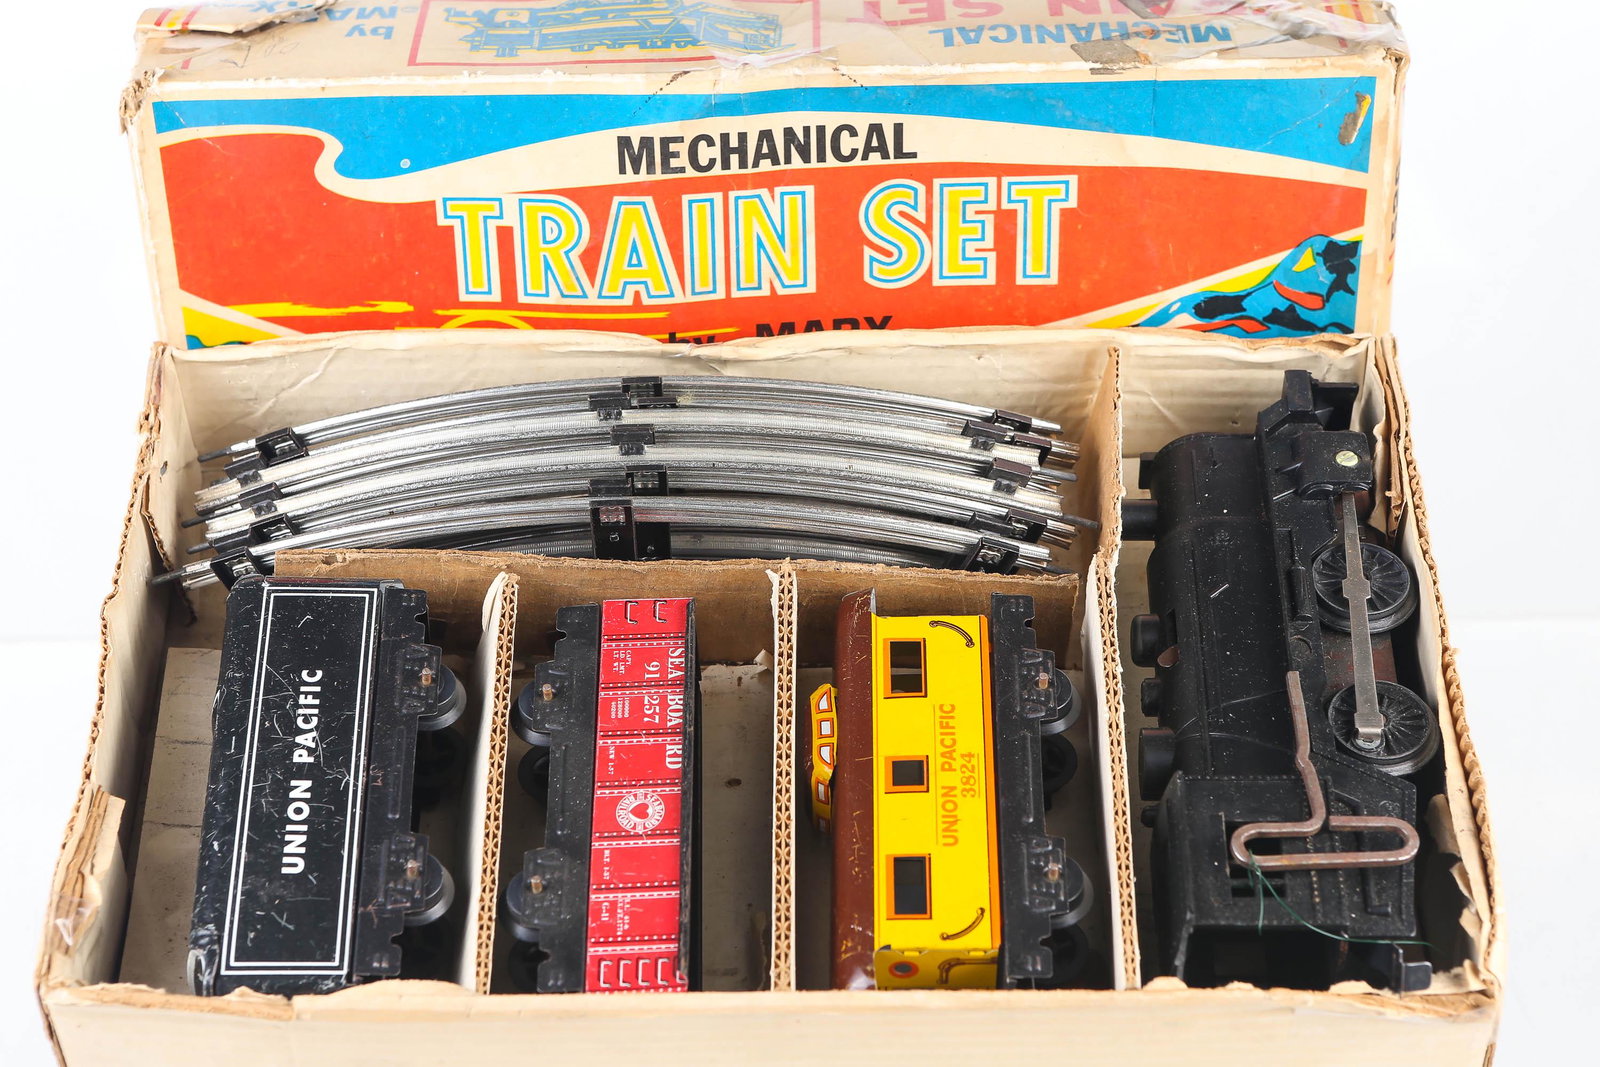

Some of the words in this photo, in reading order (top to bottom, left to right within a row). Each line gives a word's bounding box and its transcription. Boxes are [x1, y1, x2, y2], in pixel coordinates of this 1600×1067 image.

[345, 25, 394, 40] by
[928, 21, 1232, 48] MECHANICAL
[617, 122, 918, 175] MECHANICAL
[437, 186, 815, 304] TRAIN
[859, 175, 1077, 289] SET
[644, 661, 660, 680] 91
[667, 647, 685, 679] SEA
[292, 669, 323, 764] PACIFIC
[643, 695, 660, 723] 257
[667, 694, 684, 727] BOA
[938, 703, 957, 772] PACIFIC
[959, 751, 977, 798] 3824
[281, 779, 313, 875] UNION
[617, 794, 636, 830] RAILROAD
[644, 793, 664, 828] SEABOARD
[940, 785, 960, 847] UNION
